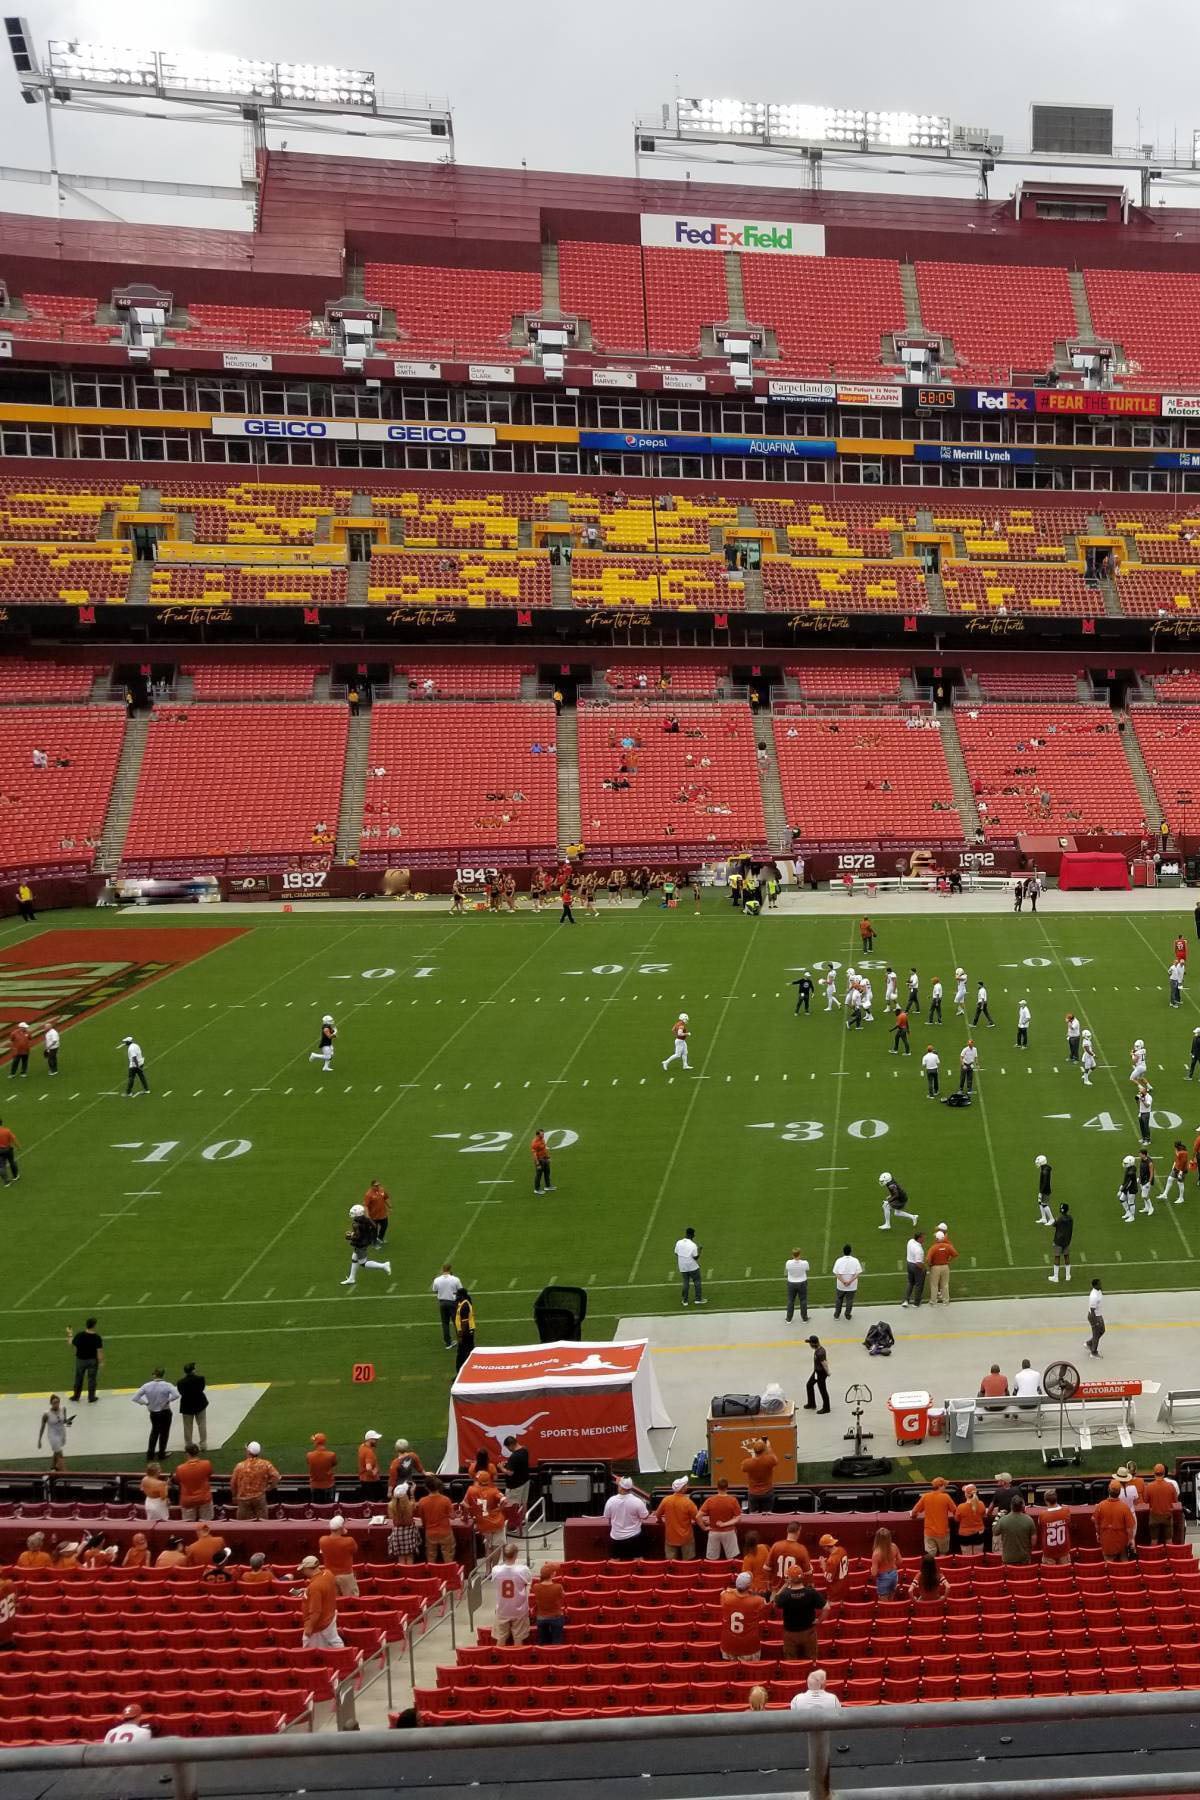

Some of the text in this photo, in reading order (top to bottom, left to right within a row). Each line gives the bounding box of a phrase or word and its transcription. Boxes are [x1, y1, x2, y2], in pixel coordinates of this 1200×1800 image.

[675, 221, 793, 250] FedExField
[772, 382, 823, 395] Carpetland
[840, 394, 869, 402] Support
[870, 394, 899, 402] LEARN
[977, 391, 1028, 410] FedEx
[1166, 399, 1176, 407] At
[244, 420, 326, 437] GEICO
[387, 426, 466, 442] GEICO
[639, 438, 668, 449] pepsi
[750, 439, 796, 456] AQUAFINA
[953, 449, 982, 461] Merrill
[984, 450, 1010, 462] Lynch
[837, 854, 875, 869] 1972
[282, 872, 326, 889] 1937
[781, 1119, 889, 1142] 30
[132, 1139, 253, 1162] 10
[355, 1366, 371, 1382] 20
[1082, 1385, 1126, 1394] GATORADE
[540, 1424, 628, 1438] SPORTS MEDICINE
[902, 1414, 920, 1432] G
[1046, 1526, 1066, 1546] 20
[502, 1580, 515, 1598] 8
[730, 1612, 744, 1634] 6
